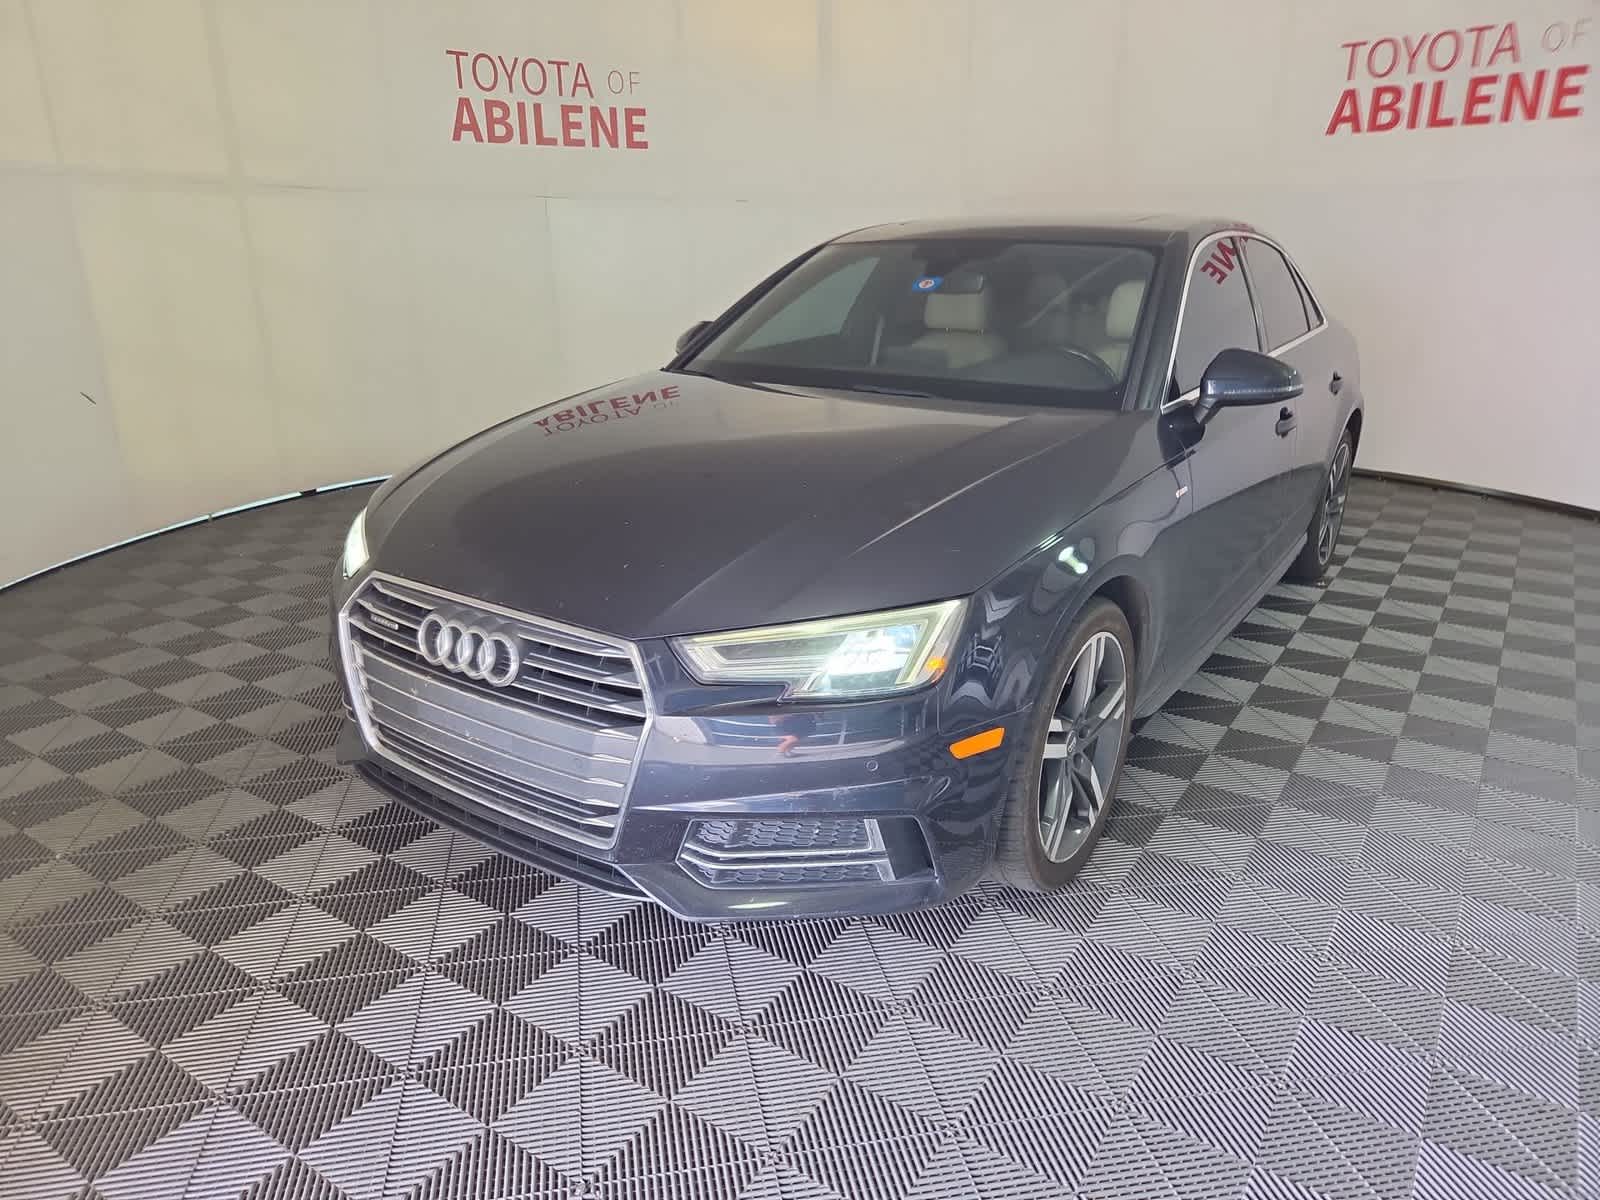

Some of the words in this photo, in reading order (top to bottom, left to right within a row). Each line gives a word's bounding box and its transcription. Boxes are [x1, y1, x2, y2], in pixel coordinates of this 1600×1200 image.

[445, 49, 594, 98] TOYOTA
[607, 70, 640, 95] OF
[1340, 21, 1521, 81] TOYOTA
[1542, 18, 1592, 53] OF
[452, 97, 649, 149] ABILENE
[1325, 64, 1590, 136] ABILENE
